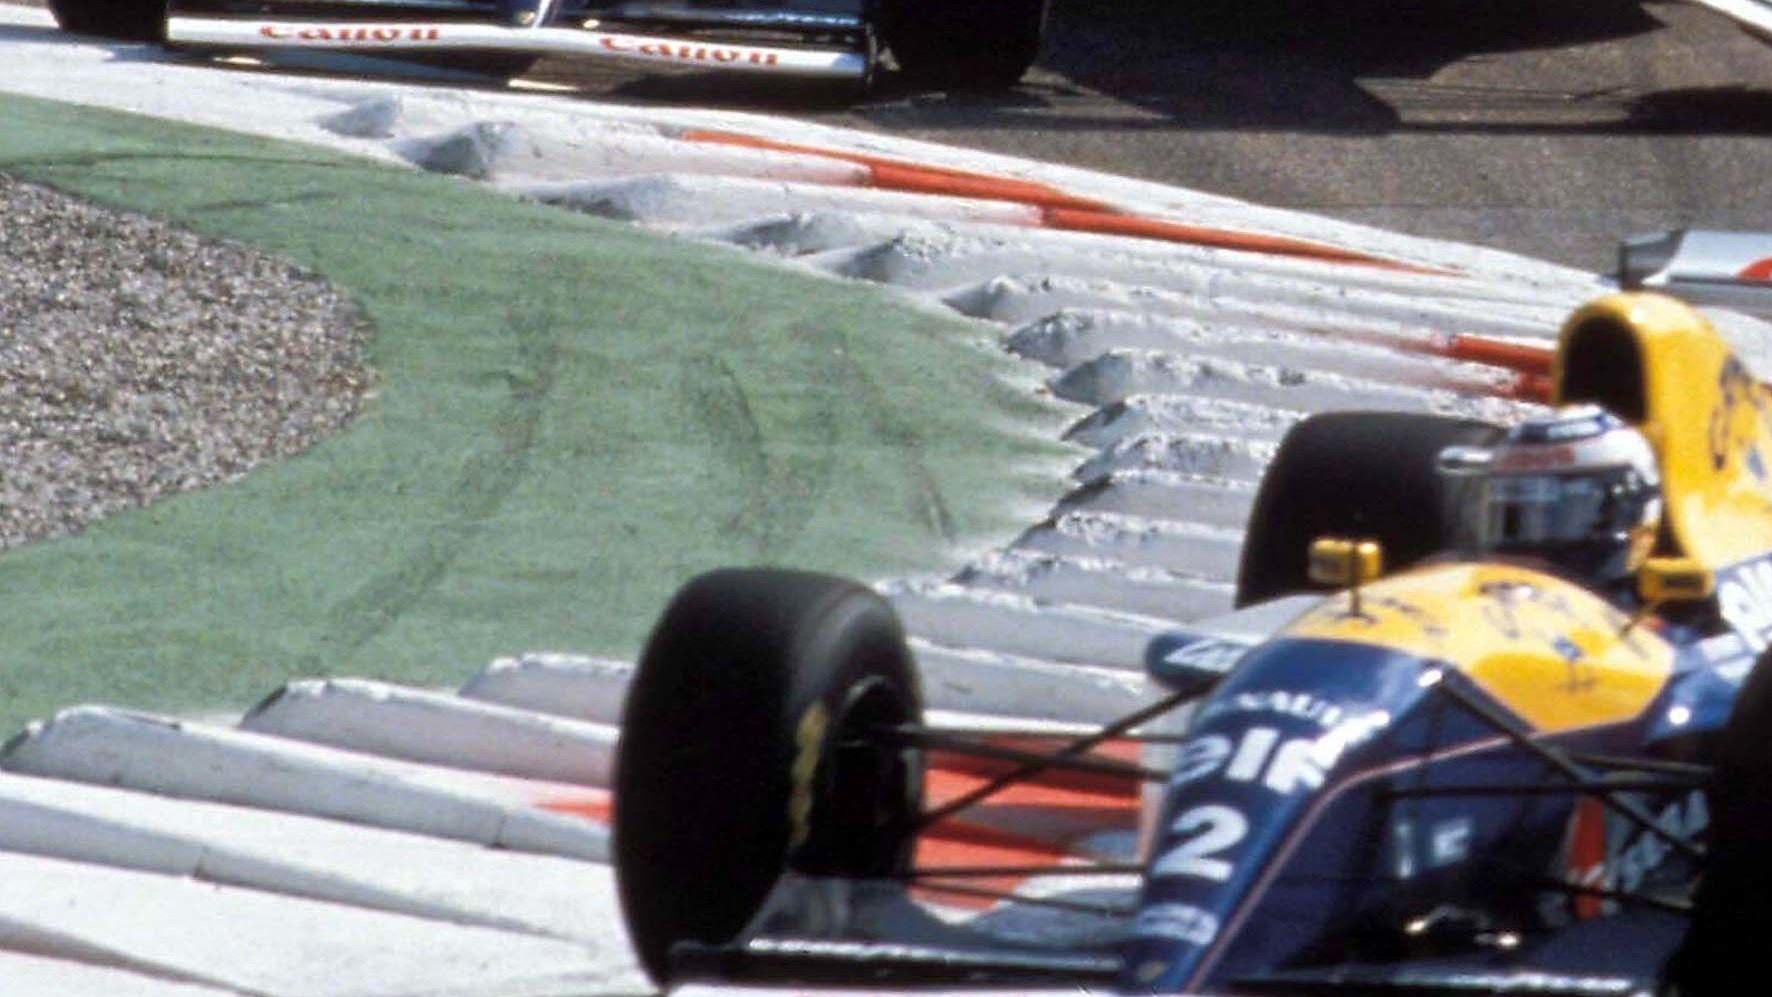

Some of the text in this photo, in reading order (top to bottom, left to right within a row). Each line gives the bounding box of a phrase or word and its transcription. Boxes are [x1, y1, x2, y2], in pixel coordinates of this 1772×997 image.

[259, 25, 440, 42] Canon
[600, 37, 779, 66] Canon
[1153, 803, 1250, 881] 2
